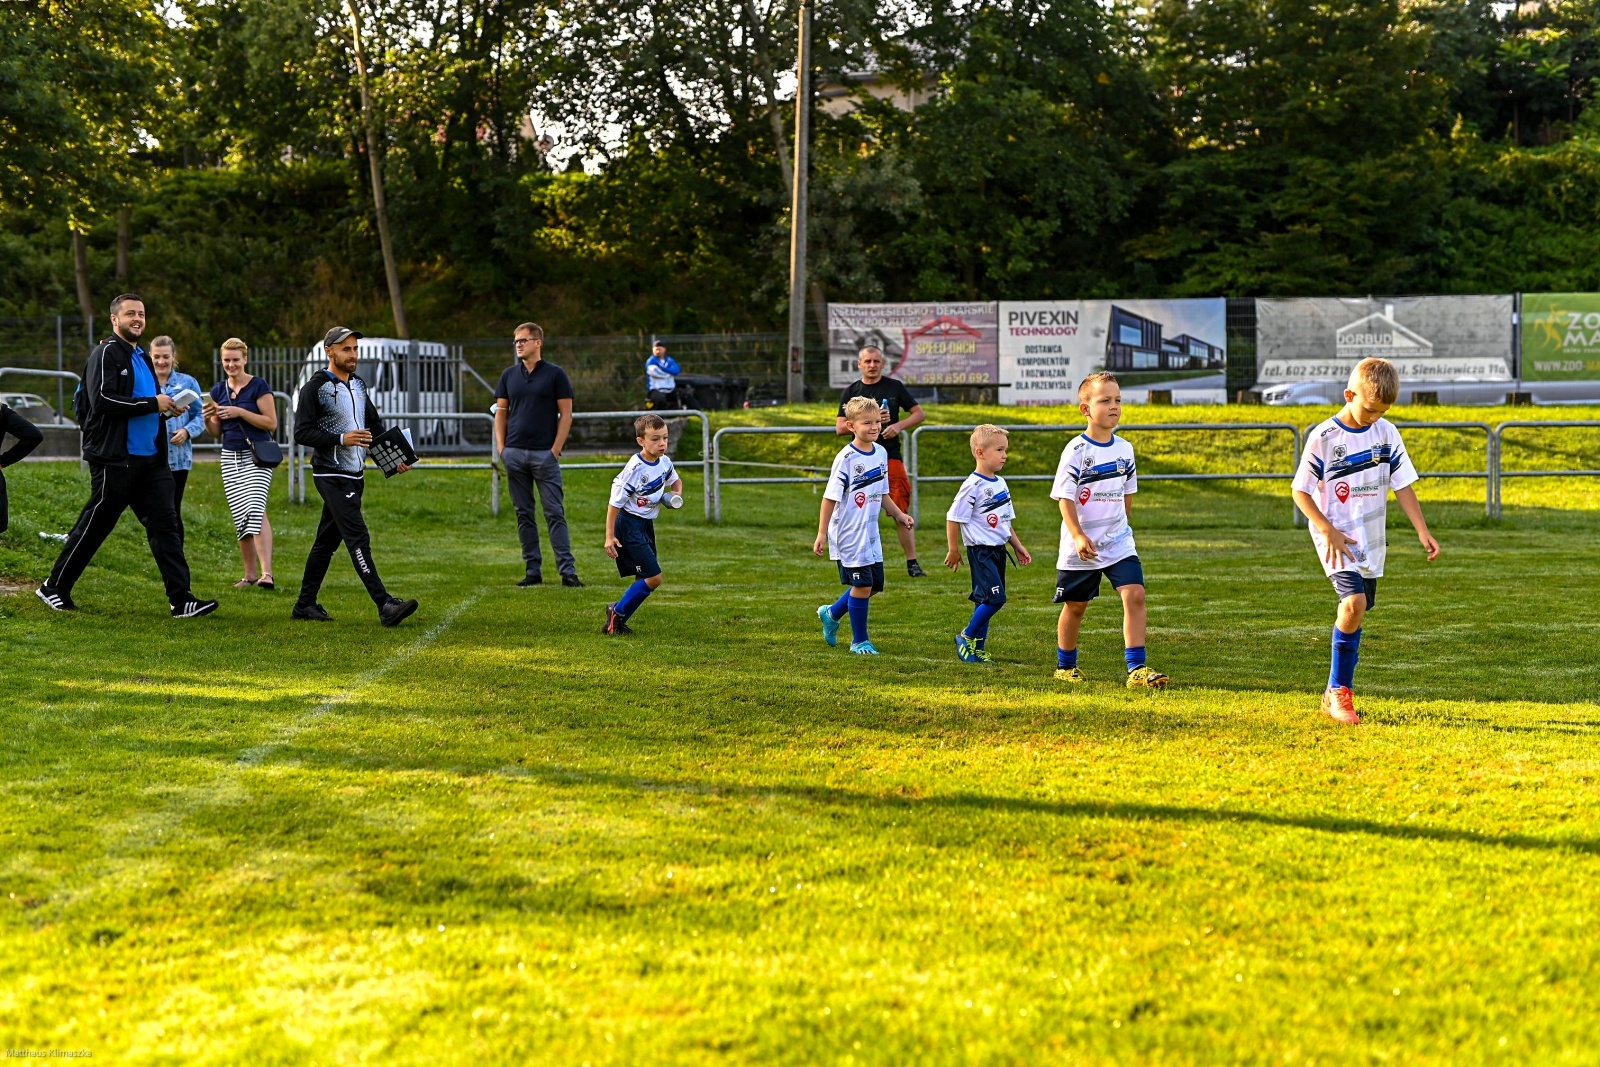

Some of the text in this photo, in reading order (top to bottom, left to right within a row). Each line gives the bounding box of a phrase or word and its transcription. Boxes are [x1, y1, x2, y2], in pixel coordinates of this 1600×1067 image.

[936, 304, 994, 315] DEKARSKIE
[1008, 310, 1079, 326] PIVEXIN
[1009, 327, 1078, 336] TECHNOLOGY
[1337, 333, 1392, 345] DORBUD
[1025, 345, 1063, 354] DOSTAWCA
[1017, 356, 1070, 366] KOMPONENTÓW
[1026, 368, 1067, 378] ROZWIĄZAŃ
[1264, 366, 1283, 376] tel.
[1286, 366, 1307, 376] 602
[1412, 364, 1485, 375] Sienkiewicza
[945, 373, 967, 383] 650
[969, 373, 990, 383] 692
[1016, 381, 1073, 390] DLA PRZEMYSŁU
